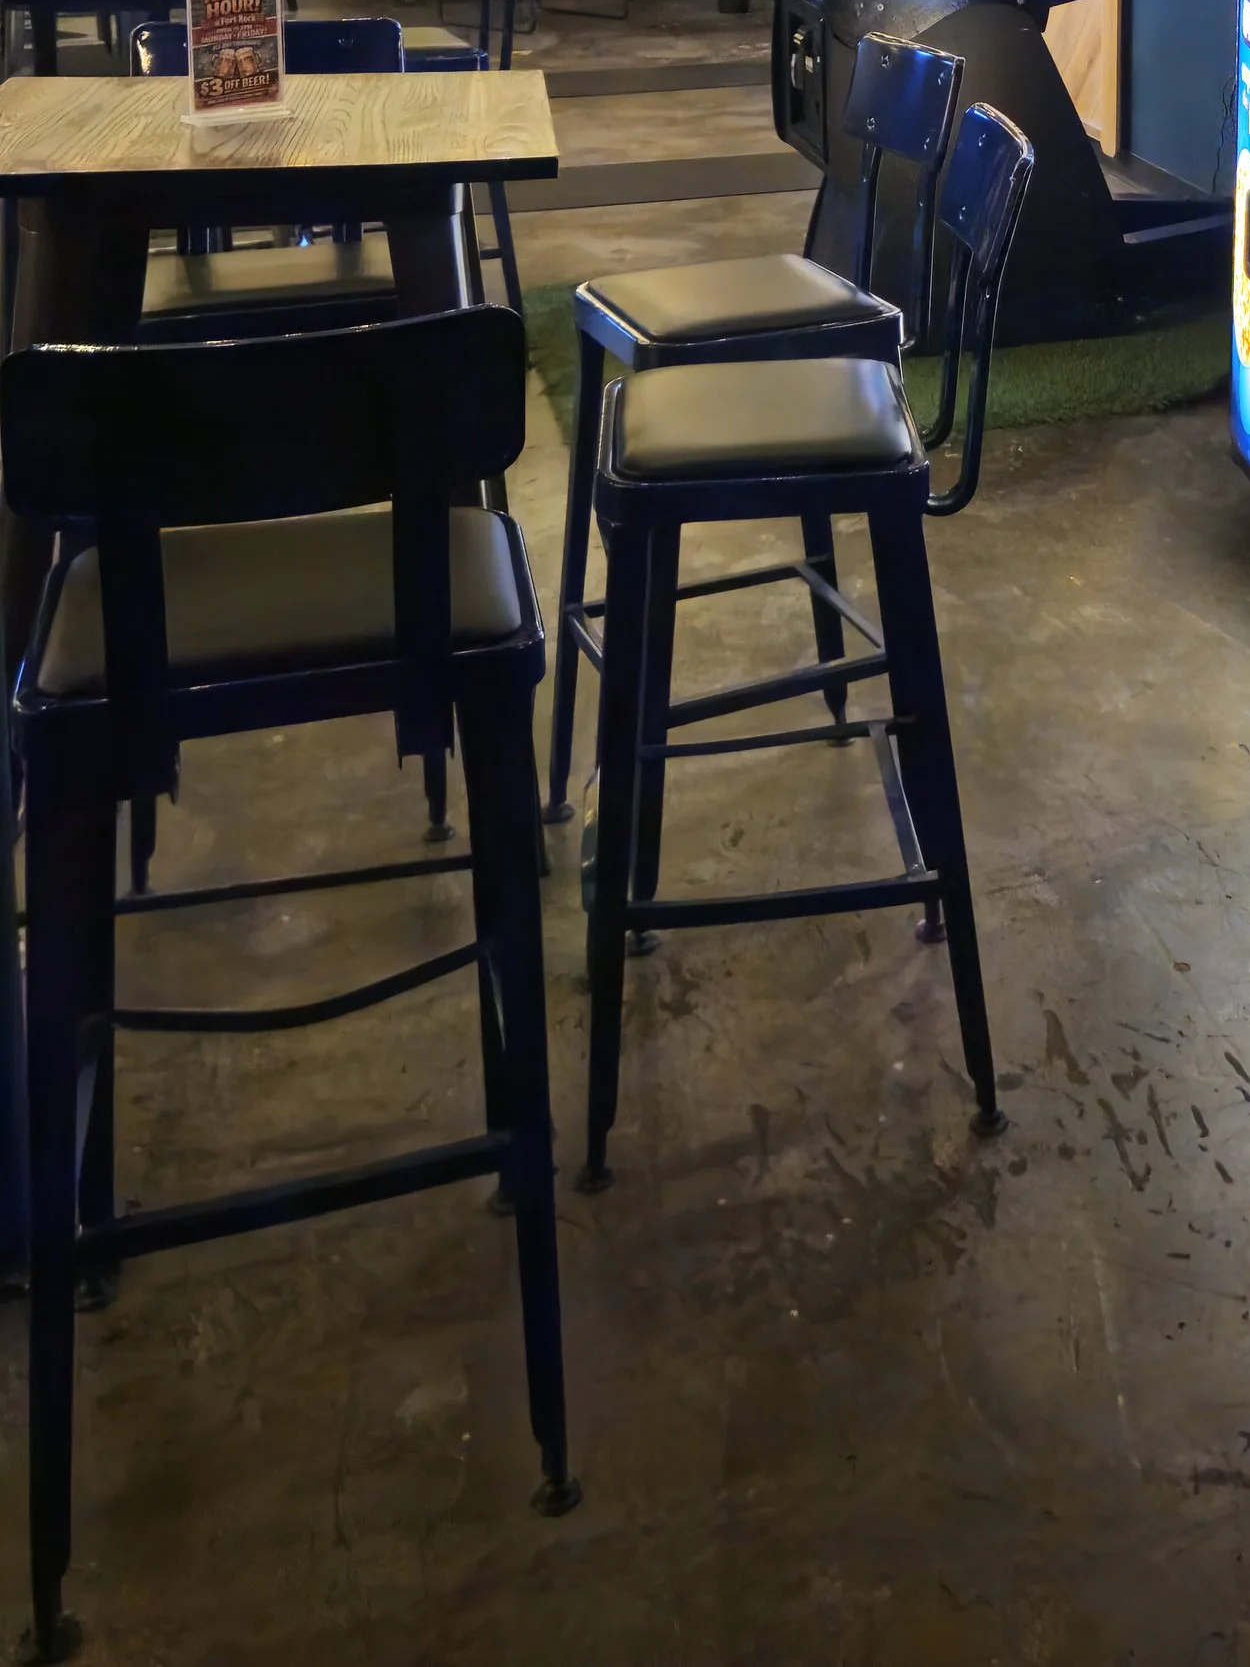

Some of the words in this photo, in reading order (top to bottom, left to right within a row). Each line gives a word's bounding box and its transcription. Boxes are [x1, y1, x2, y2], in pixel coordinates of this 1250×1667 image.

[221, 16, 236, 25] Fort
[238, 14, 257, 23] Rock
[201, 33, 232, 43] MONDAY
[200, 78, 224, 96] $3
[224, 79, 240, 90] OFF
[242, 74, 270, 88] BEER!
